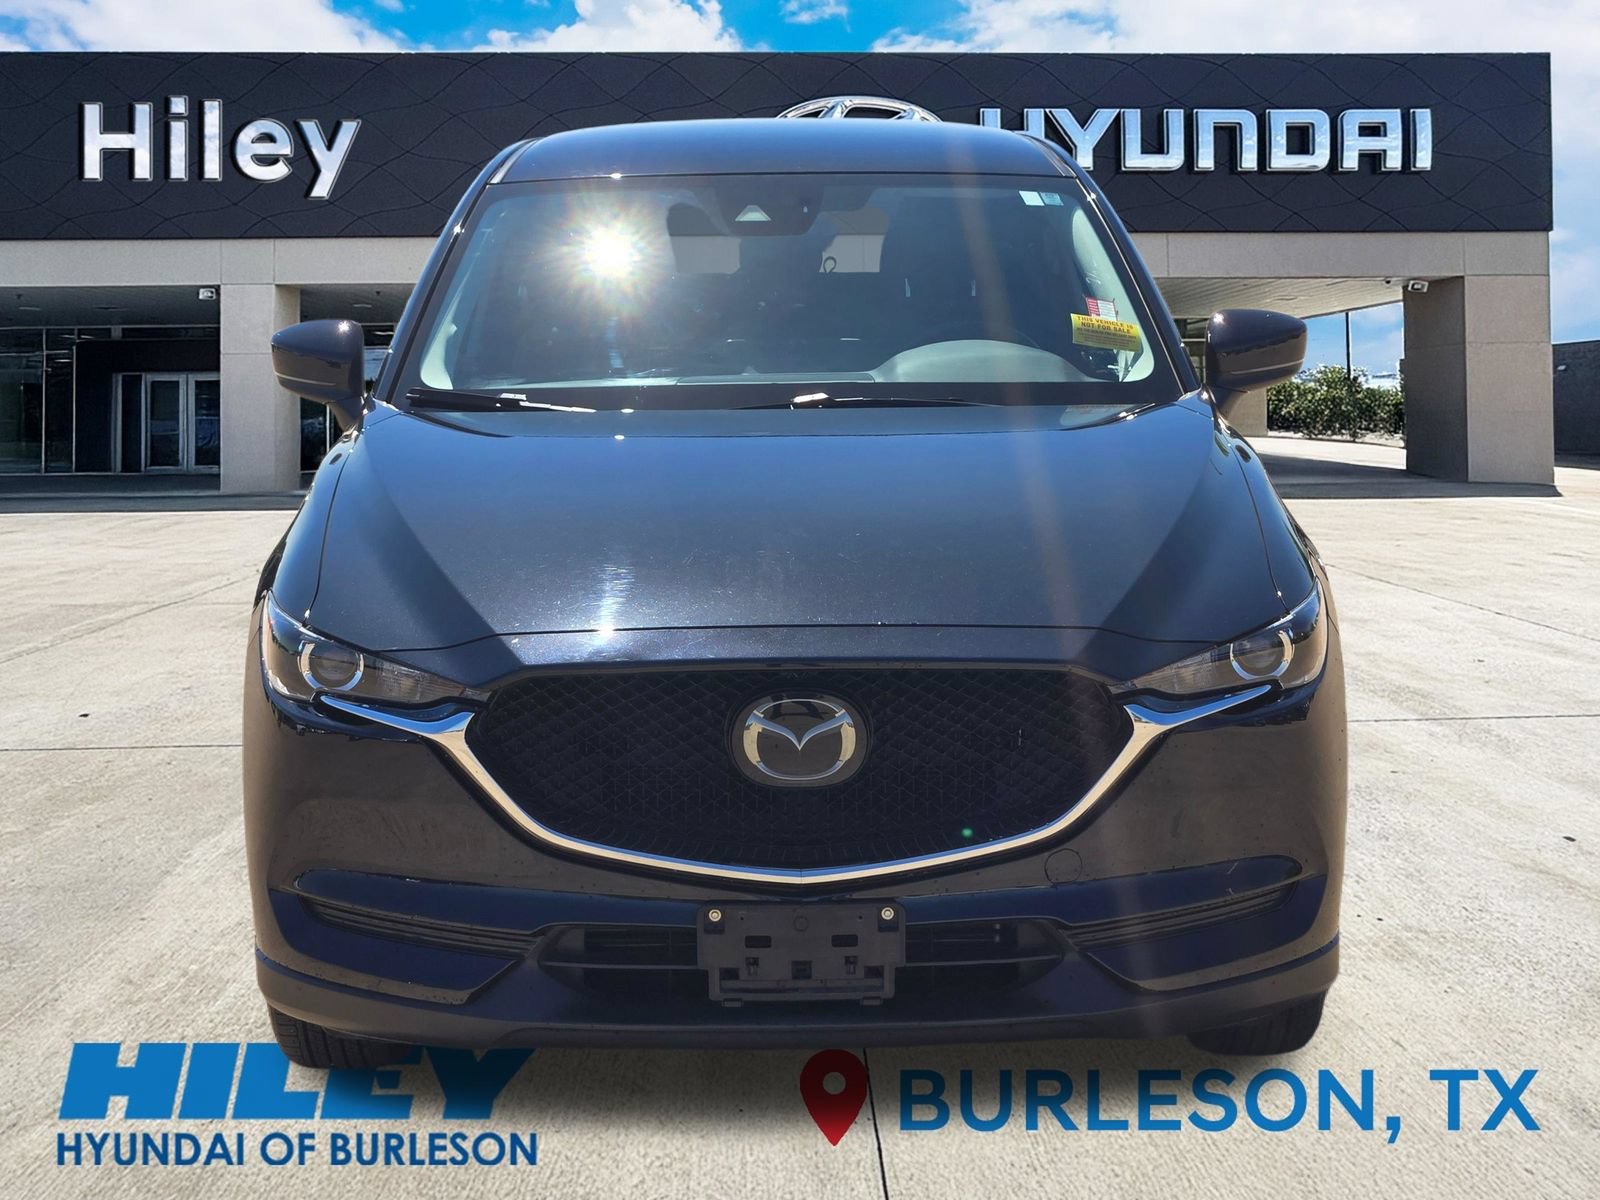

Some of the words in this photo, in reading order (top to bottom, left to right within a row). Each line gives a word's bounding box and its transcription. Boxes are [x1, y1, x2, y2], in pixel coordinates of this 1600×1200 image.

[80, 95, 361, 200] Hiley
[1095, 319, 1124, 327] VEHICLE
[1113, 326, 1131, 334] SALE
